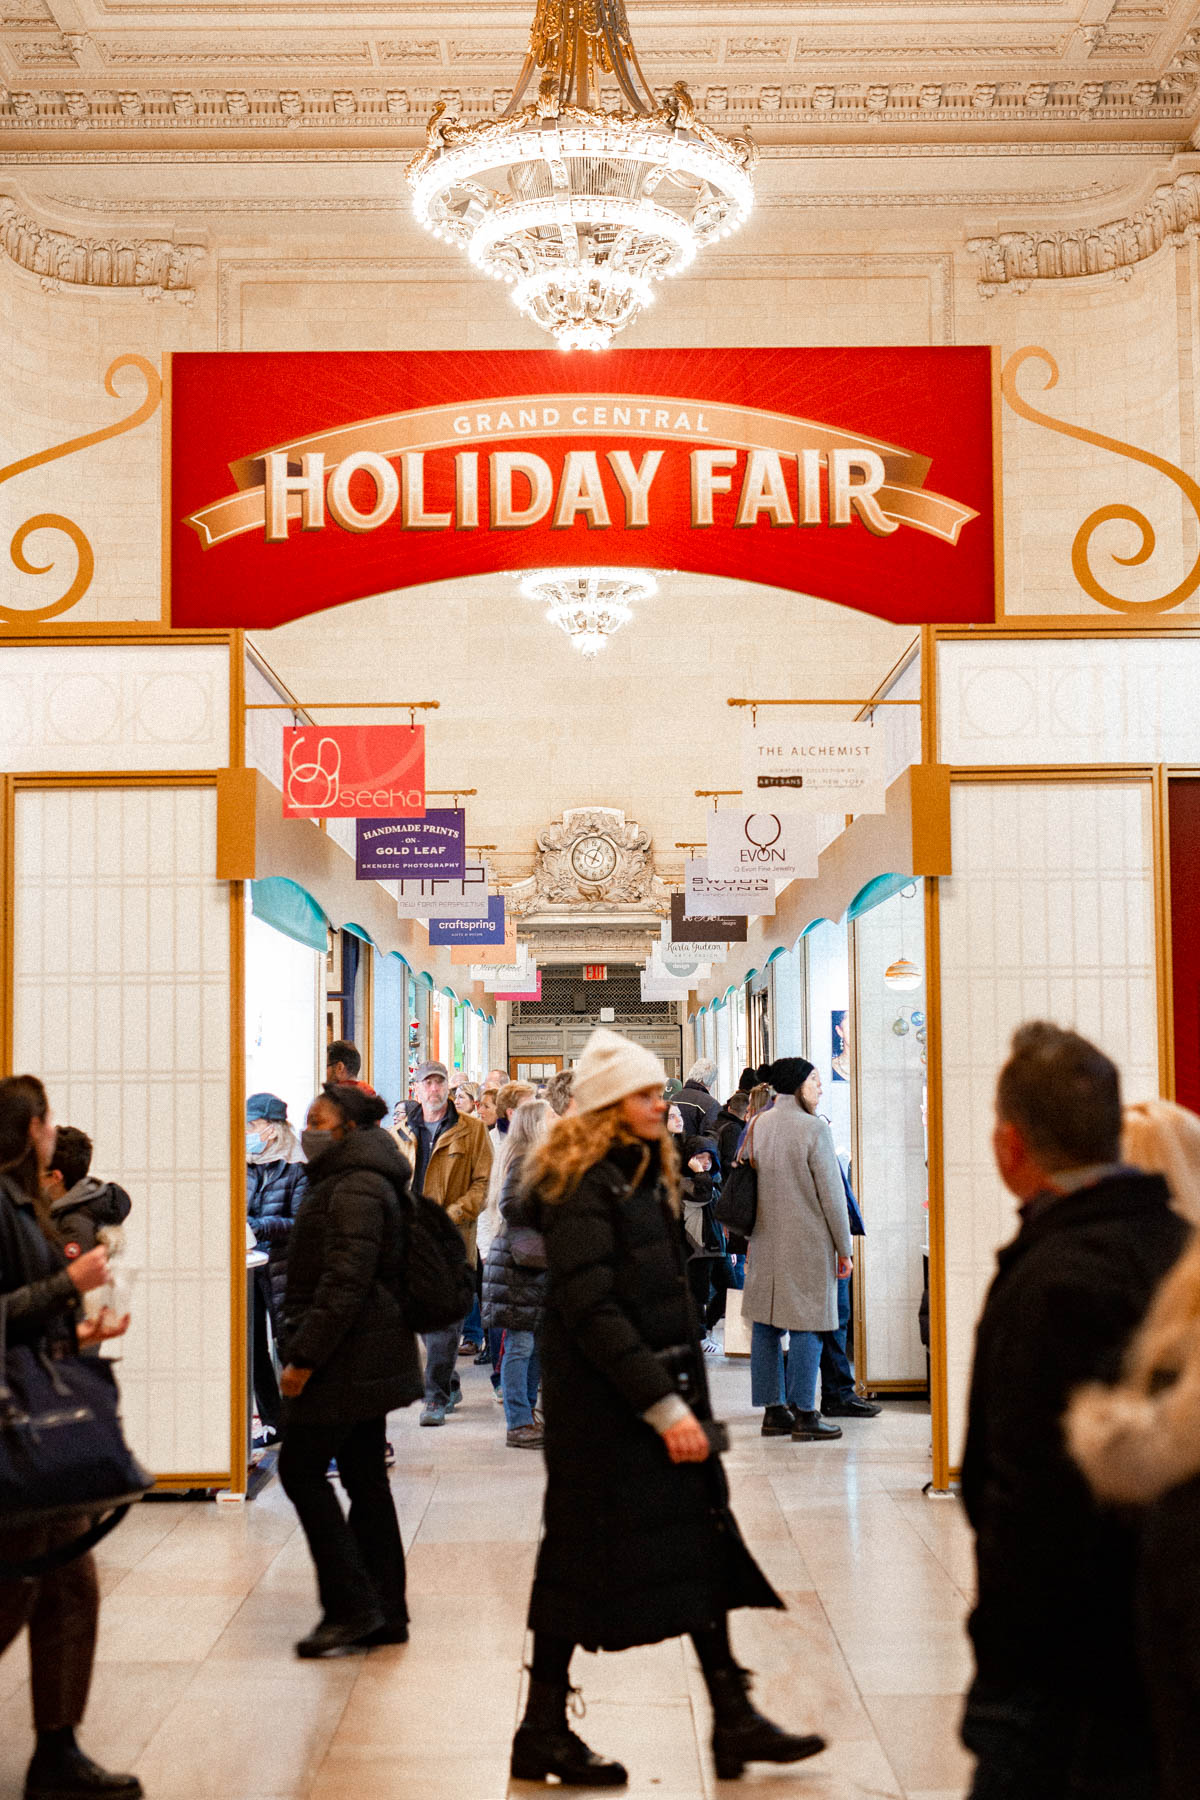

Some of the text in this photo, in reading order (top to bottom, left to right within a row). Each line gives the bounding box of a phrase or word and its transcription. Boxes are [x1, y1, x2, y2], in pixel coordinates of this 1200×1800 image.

[453, 407, 709, 435] GRAND CENTRAL
[264, 449, 899, 543] HOLIDAY FAIR
[758, 746, 871, 756] THE ALCHEMIST
[340, 789, 422, 808] seeka
[363, 824, 460, 840] HANDMADE PRINTS
[376, 846, 447, 856] GOLD LEAF
[740, 849, 786, 862] EVON
[438, 920, 496, 931] craftspring
[586, 965, 605, 980] EXIT
